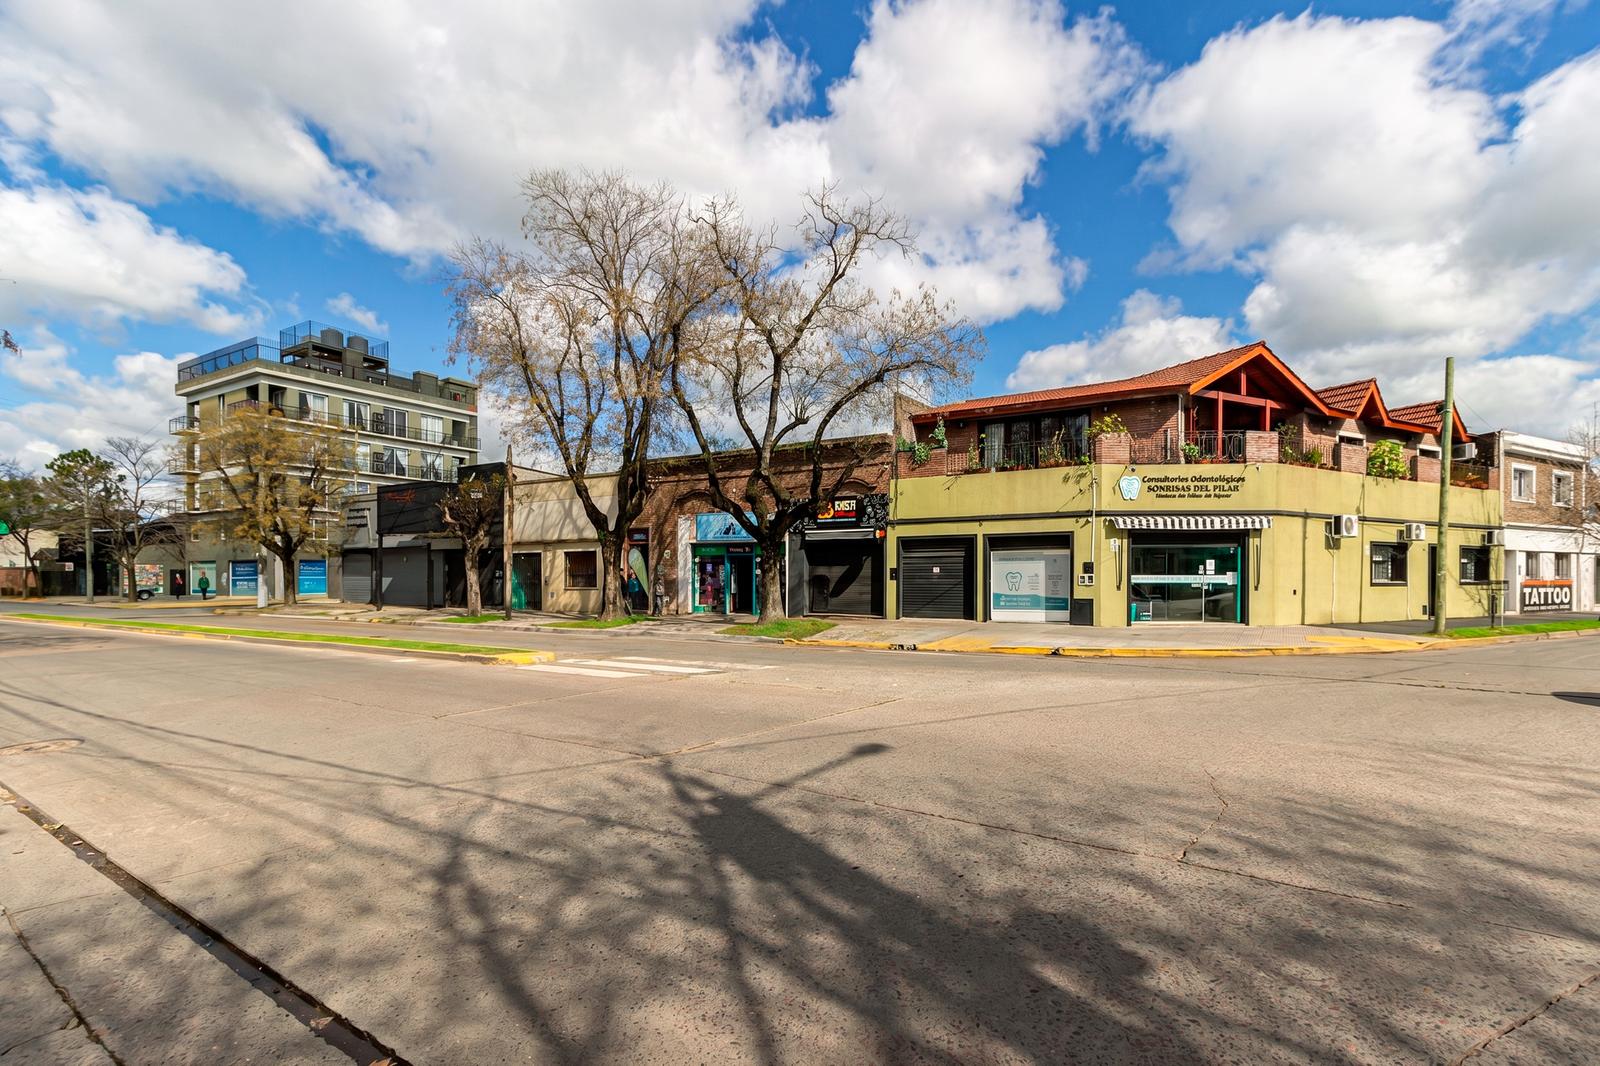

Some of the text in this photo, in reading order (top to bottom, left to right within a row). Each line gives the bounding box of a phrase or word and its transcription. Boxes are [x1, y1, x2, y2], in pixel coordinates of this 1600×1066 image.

[1142, 474, 1245, 484] Consultorios Odontológicos
[1213, 484, 1239, 492] PILAR
[1523, 588, 1570, 604] TATTOO
